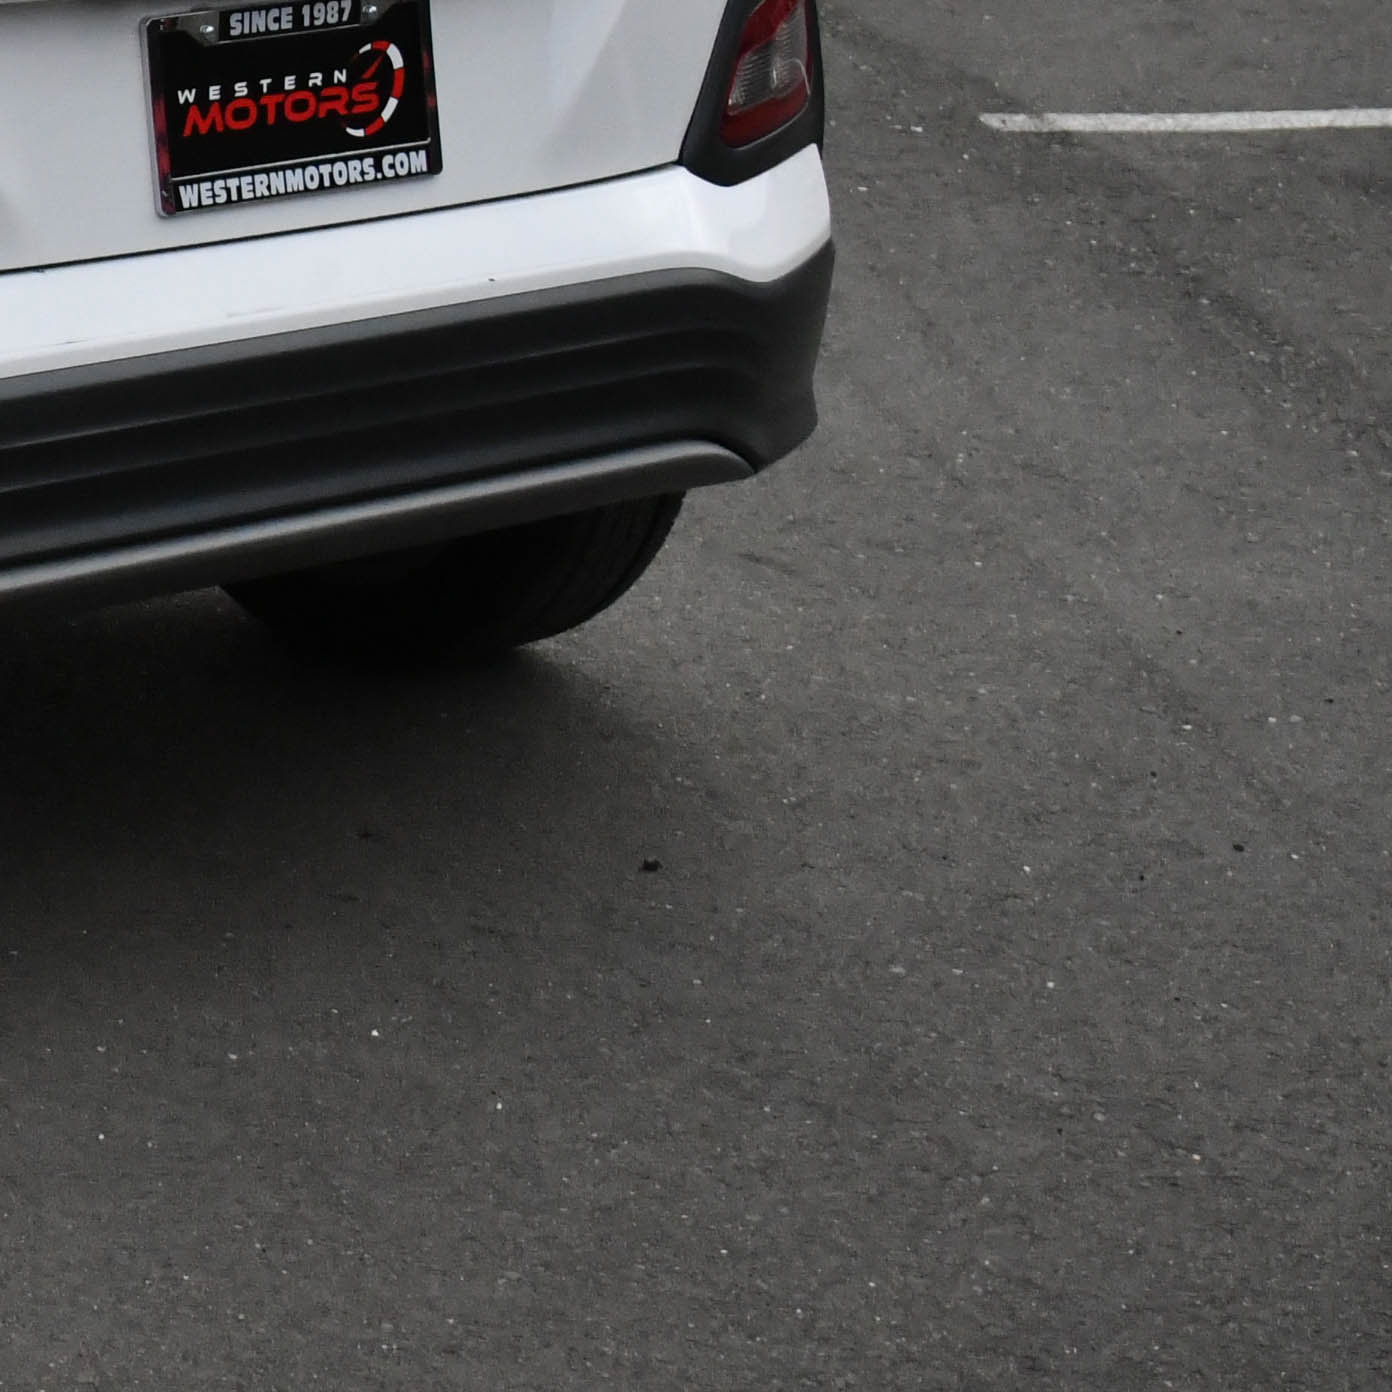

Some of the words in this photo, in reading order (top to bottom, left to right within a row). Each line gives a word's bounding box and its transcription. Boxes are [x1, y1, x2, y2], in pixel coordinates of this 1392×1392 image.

[229, 6, 293, 36] SINCE
[301, 0, 352, 27] 1987
[178, 69, 347, 105] WESTERN
[183, 82, 380, 137] MOTORS
[179, 150, 428, 209] WESTERNMOTORS.COM
